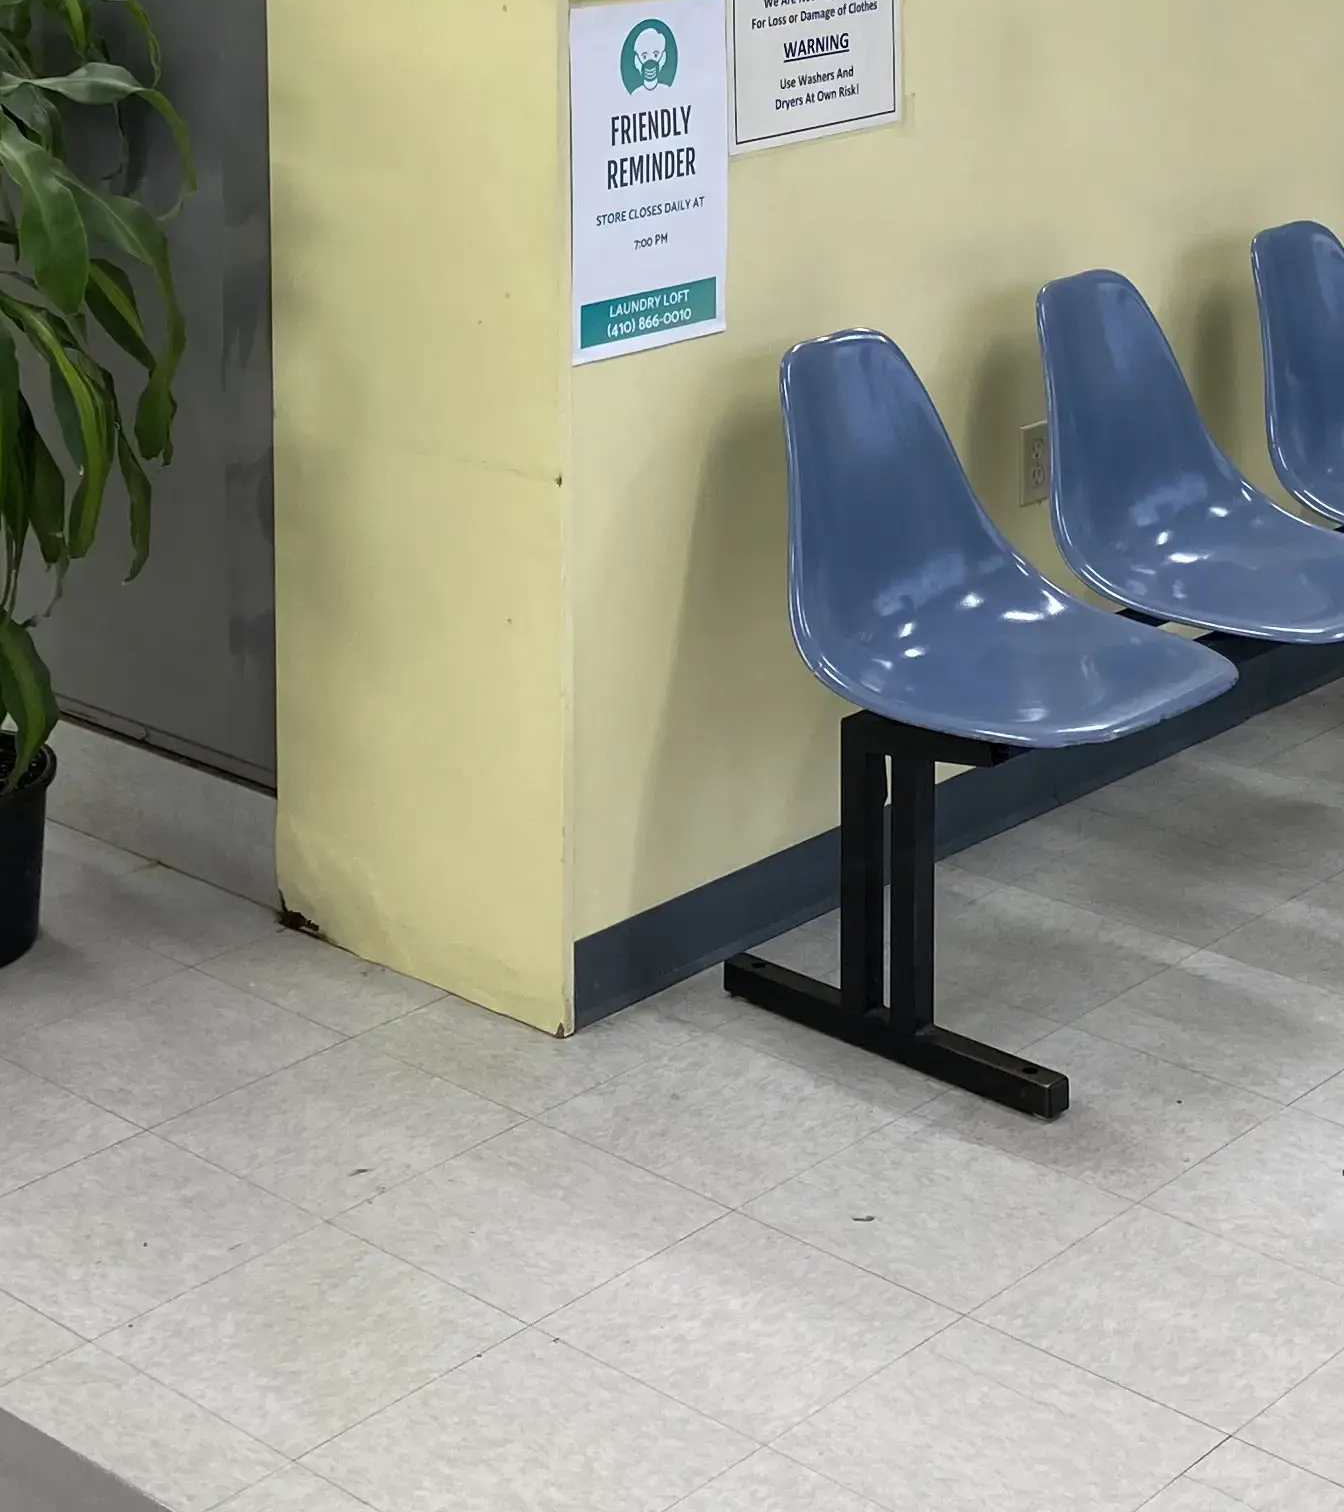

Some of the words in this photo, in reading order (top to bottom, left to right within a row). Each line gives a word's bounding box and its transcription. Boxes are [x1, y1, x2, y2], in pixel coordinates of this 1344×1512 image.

[752, 18, 766, 30] For
[768, 14, 786, 27] Loss
[789, 14, 798, 24] or
[800, 7, 835, 21] Damage
[837, 4, 847, 16] of
[848, 0, 878, 14] Clothes
[783, 32, 850, 59] WARNING
[780, 78, 796, 90] Use
[798, 70, 835, 86] Washers
[836, 65, 854, 78] And
[775, 96, 804, 110] Dryers
[805, 92, 815, 103] At
[817, 89, 837, 102] Own
[838, 83, 860, 98] Risk!
[610, 104, 692, 147] FRIENDLY
[607, 146, 696, 190] REMINDER
[596, 211, 627, 227] STORE
[628, 204, 663, 221] CLOSES
[664, 199, 691, 214] DAILY
[692, 196, 705, 208] AT
[634, 237, 653, 250] 7:00
[655, 232, 668, 245] PM
[609, 294, 662, 318] LAUNDRY
[663, 289, 690, 307] LOFT
[607, 318, 636, 338] (410)
[638, 308, 692, 330] 866-0010
